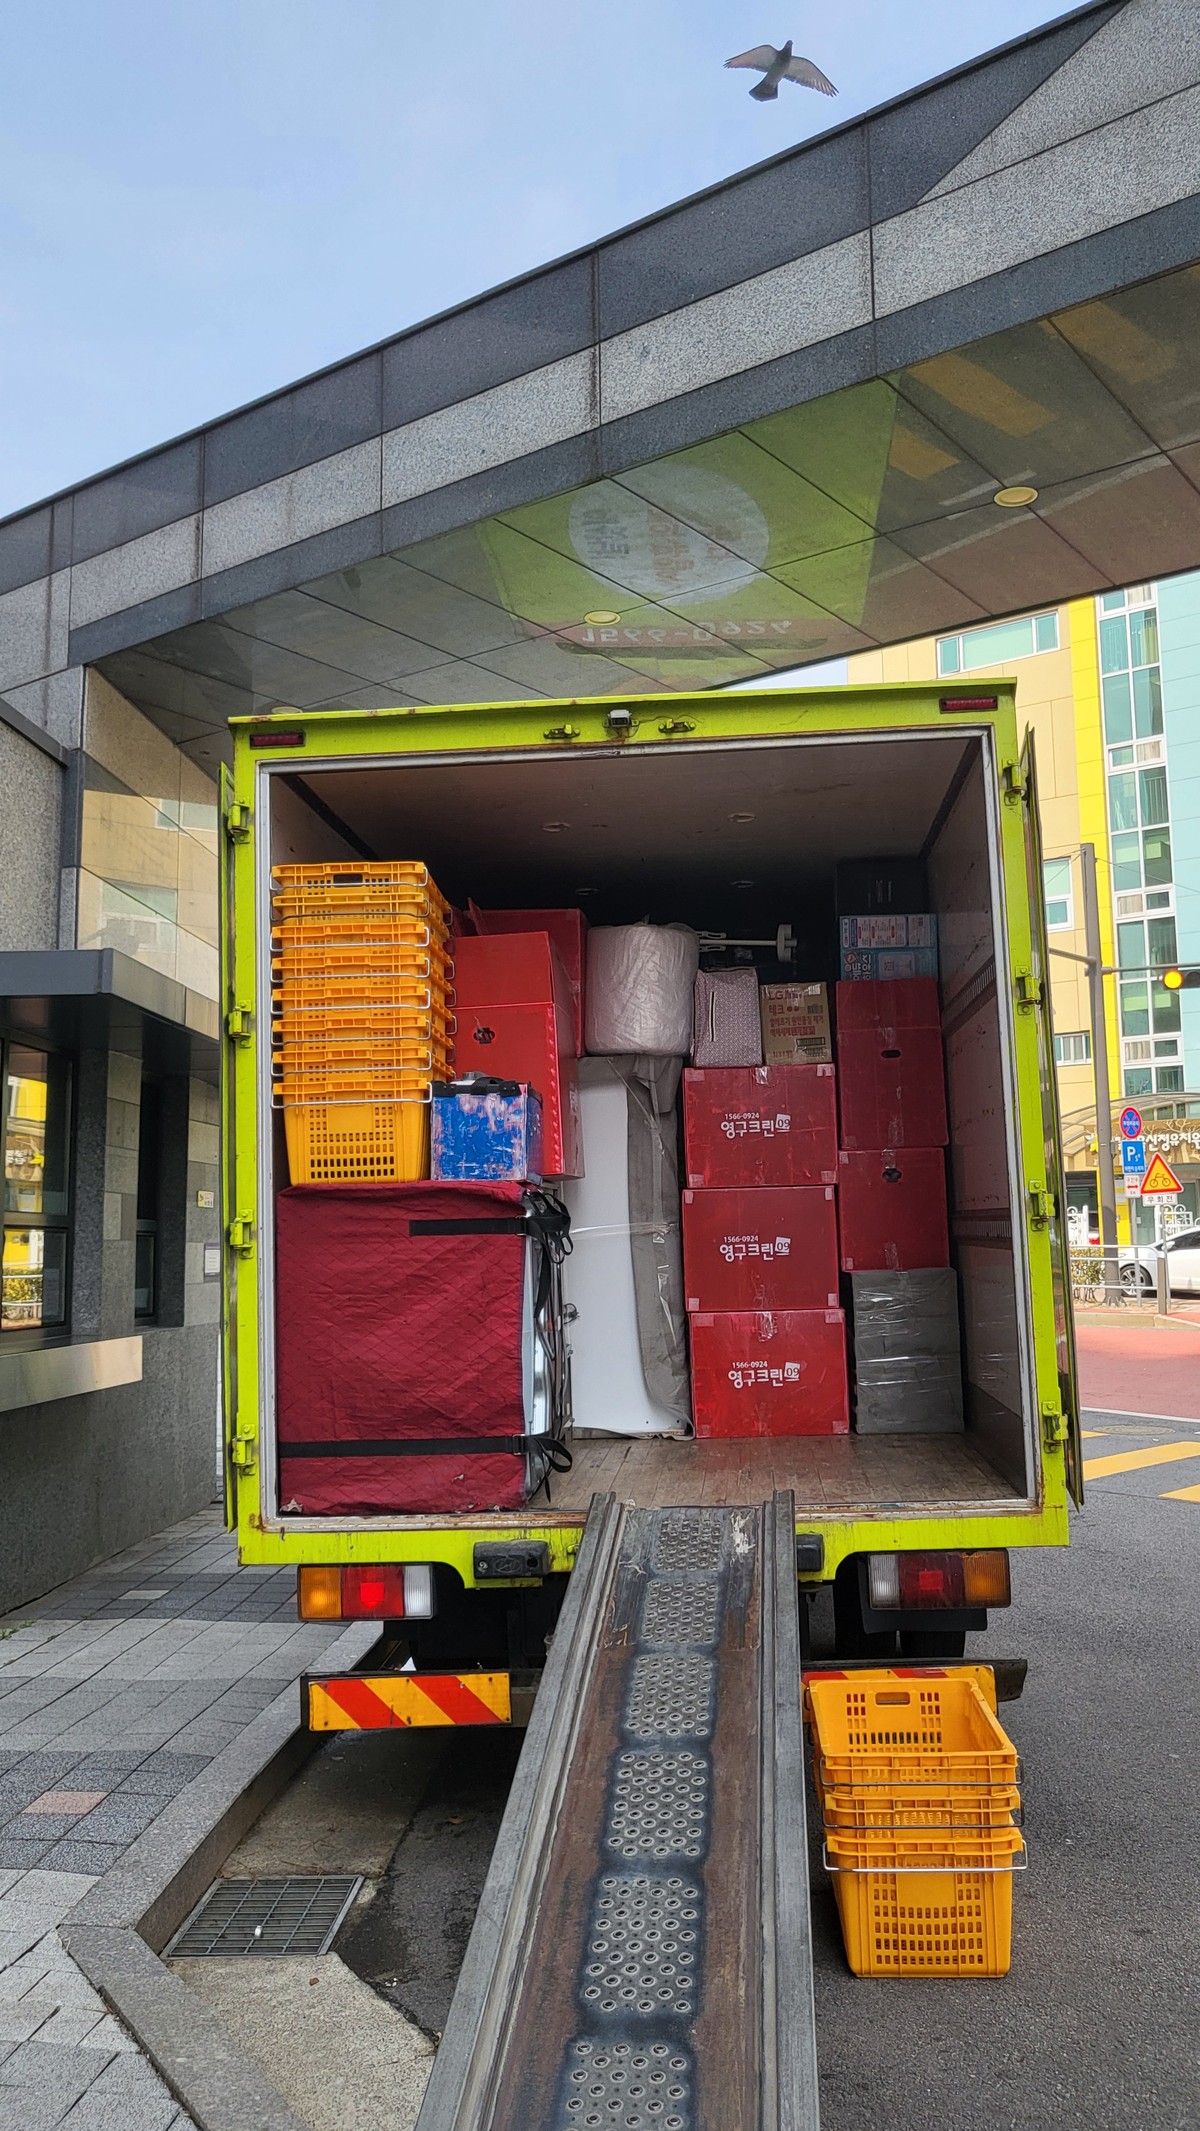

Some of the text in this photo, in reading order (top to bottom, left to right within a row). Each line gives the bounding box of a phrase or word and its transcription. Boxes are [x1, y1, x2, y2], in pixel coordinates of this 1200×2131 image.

[724, 1112, 760, 1120] 1566-0924
[721, 1120, 774, 1138] 영구크린
[720, 1243, 774, 1261] 영구크린
[728, 1369, 784, 1388] 영구크린
